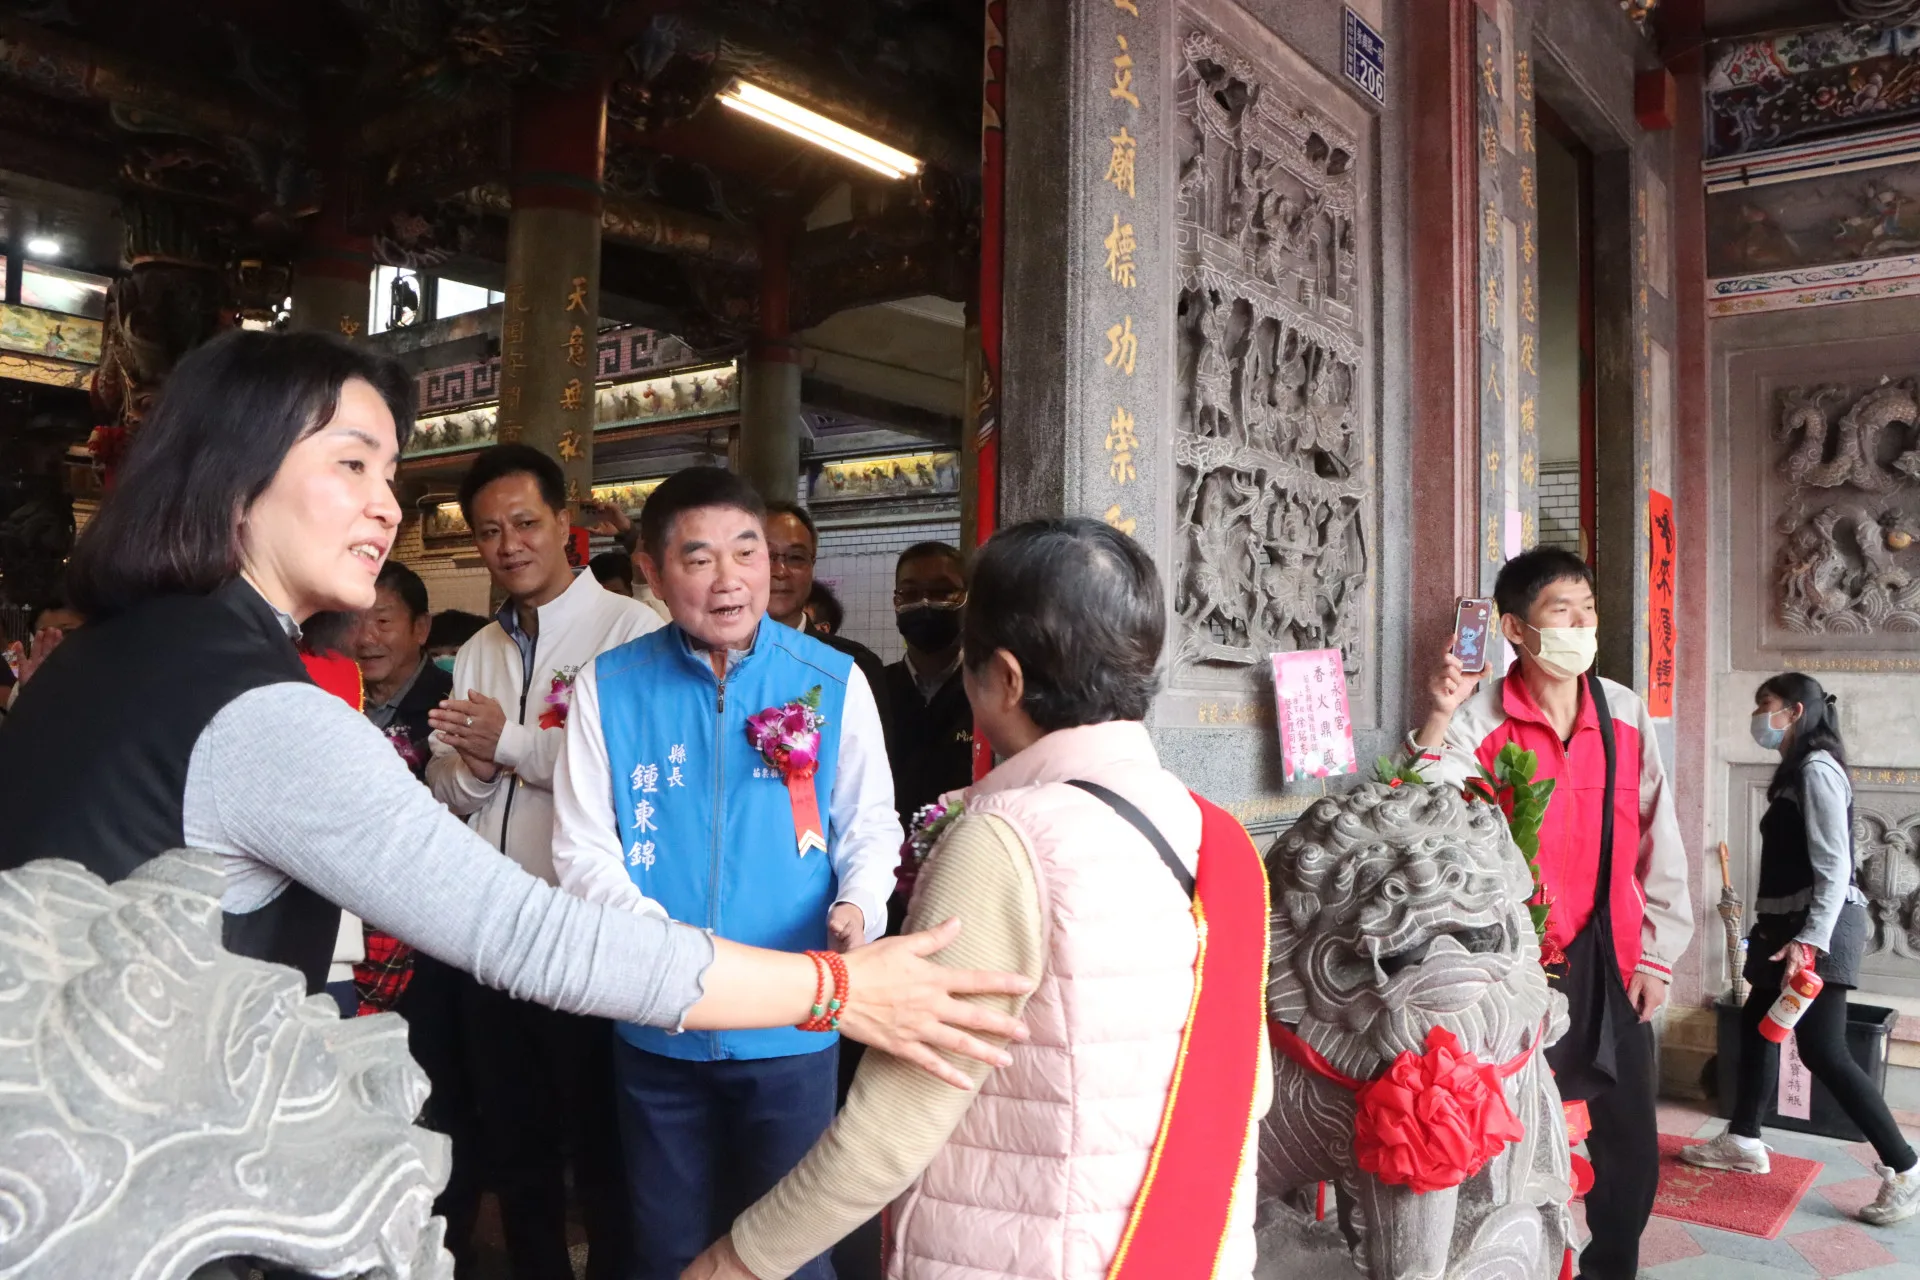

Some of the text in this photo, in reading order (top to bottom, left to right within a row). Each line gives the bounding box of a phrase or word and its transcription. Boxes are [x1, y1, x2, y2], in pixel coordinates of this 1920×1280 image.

[1360, 59, 1383, 101] 206
[563, 665, 581, 673] 立法
[1313, 666, 1337, 766] 香火鼎盛
[1328, 657, 1345, 731] 恭祝永貞宮
[666, 743, 687, 788] 縣長
[752, 767, 781, 779] 苗栗縣
[627, 762, 660, 872] 鍾東錦
